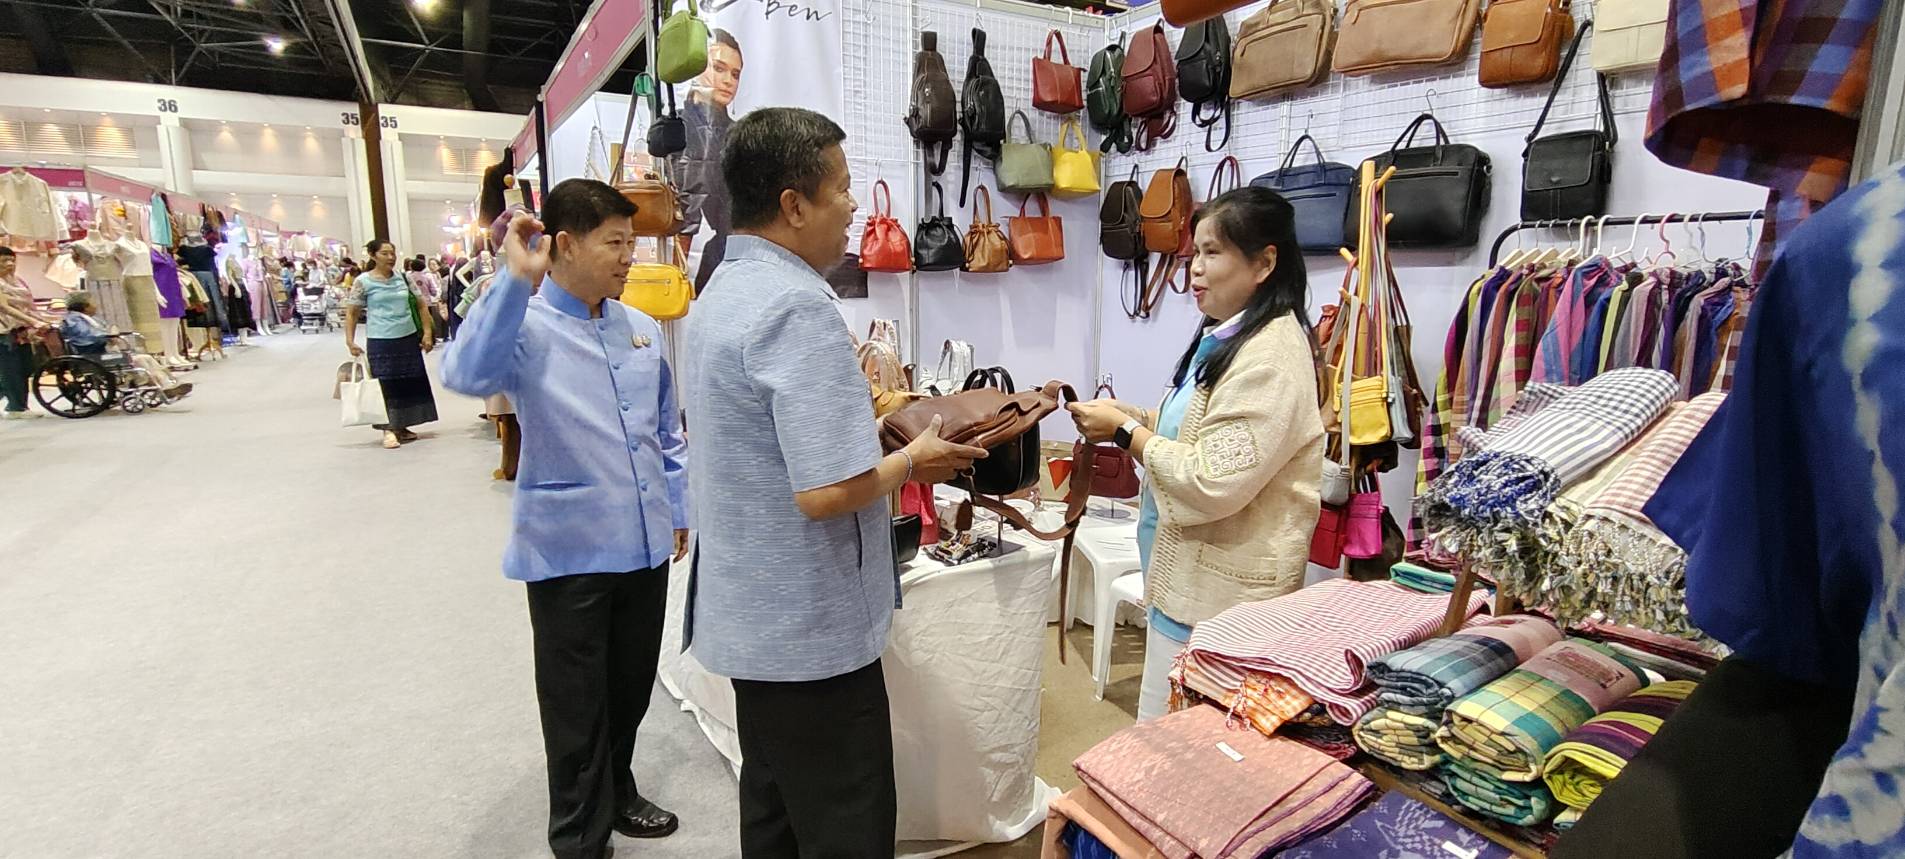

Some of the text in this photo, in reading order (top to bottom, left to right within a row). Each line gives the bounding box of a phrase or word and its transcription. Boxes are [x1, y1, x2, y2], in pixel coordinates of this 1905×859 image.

[157, 98, 179, 113] 36
[341, 112, 360, 126] 35
[380, 115, 398, 129] 35
